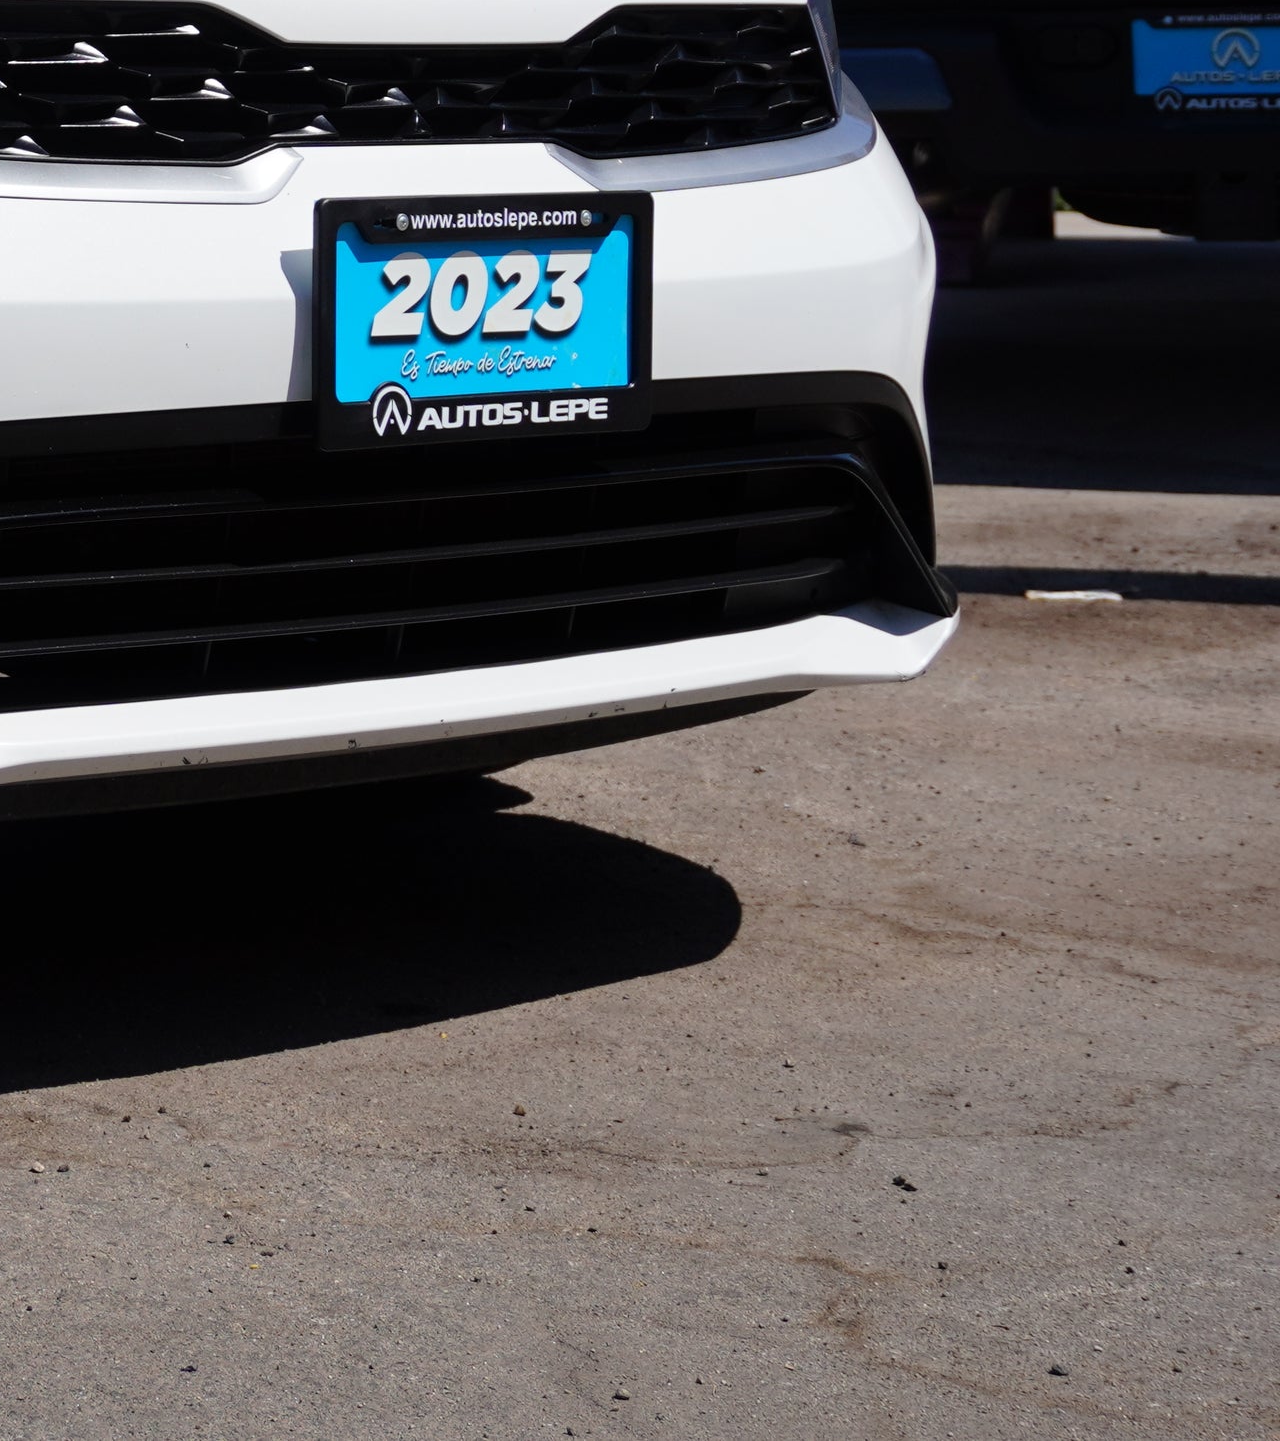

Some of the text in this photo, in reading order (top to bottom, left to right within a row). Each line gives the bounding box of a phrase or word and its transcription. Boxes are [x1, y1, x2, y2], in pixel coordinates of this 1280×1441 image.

[410, 207, 577, 231] www.autoslepe.com
[370, 249, 593, 338] 2023
[401, 345, 557, 380] Es Tiempo de Estrenar
